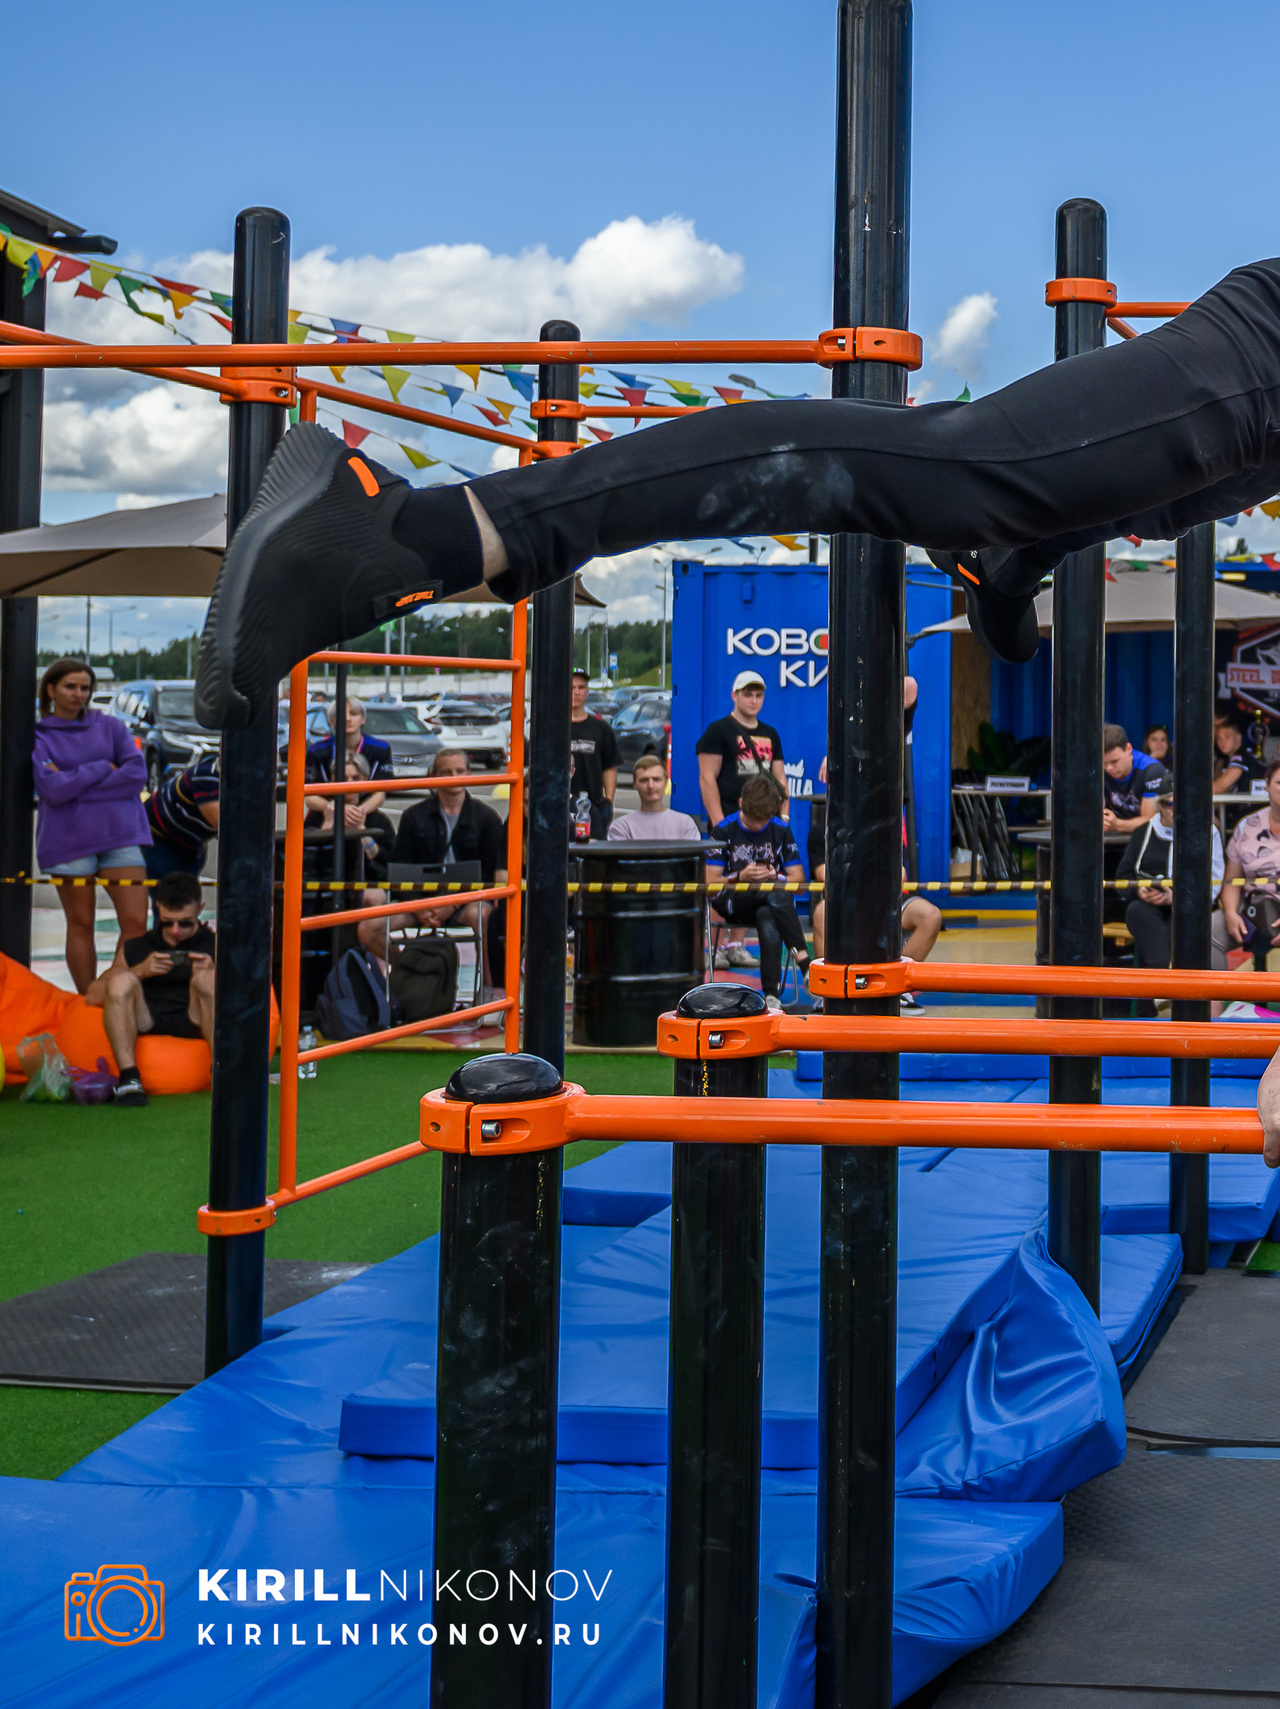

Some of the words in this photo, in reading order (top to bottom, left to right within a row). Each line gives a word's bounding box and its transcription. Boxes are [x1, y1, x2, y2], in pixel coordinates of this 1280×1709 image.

[727, 627, 829, 656] КОВО
[779, 660, 829, 687] КИ
[1228, 667, 1265, 685] STEEL
